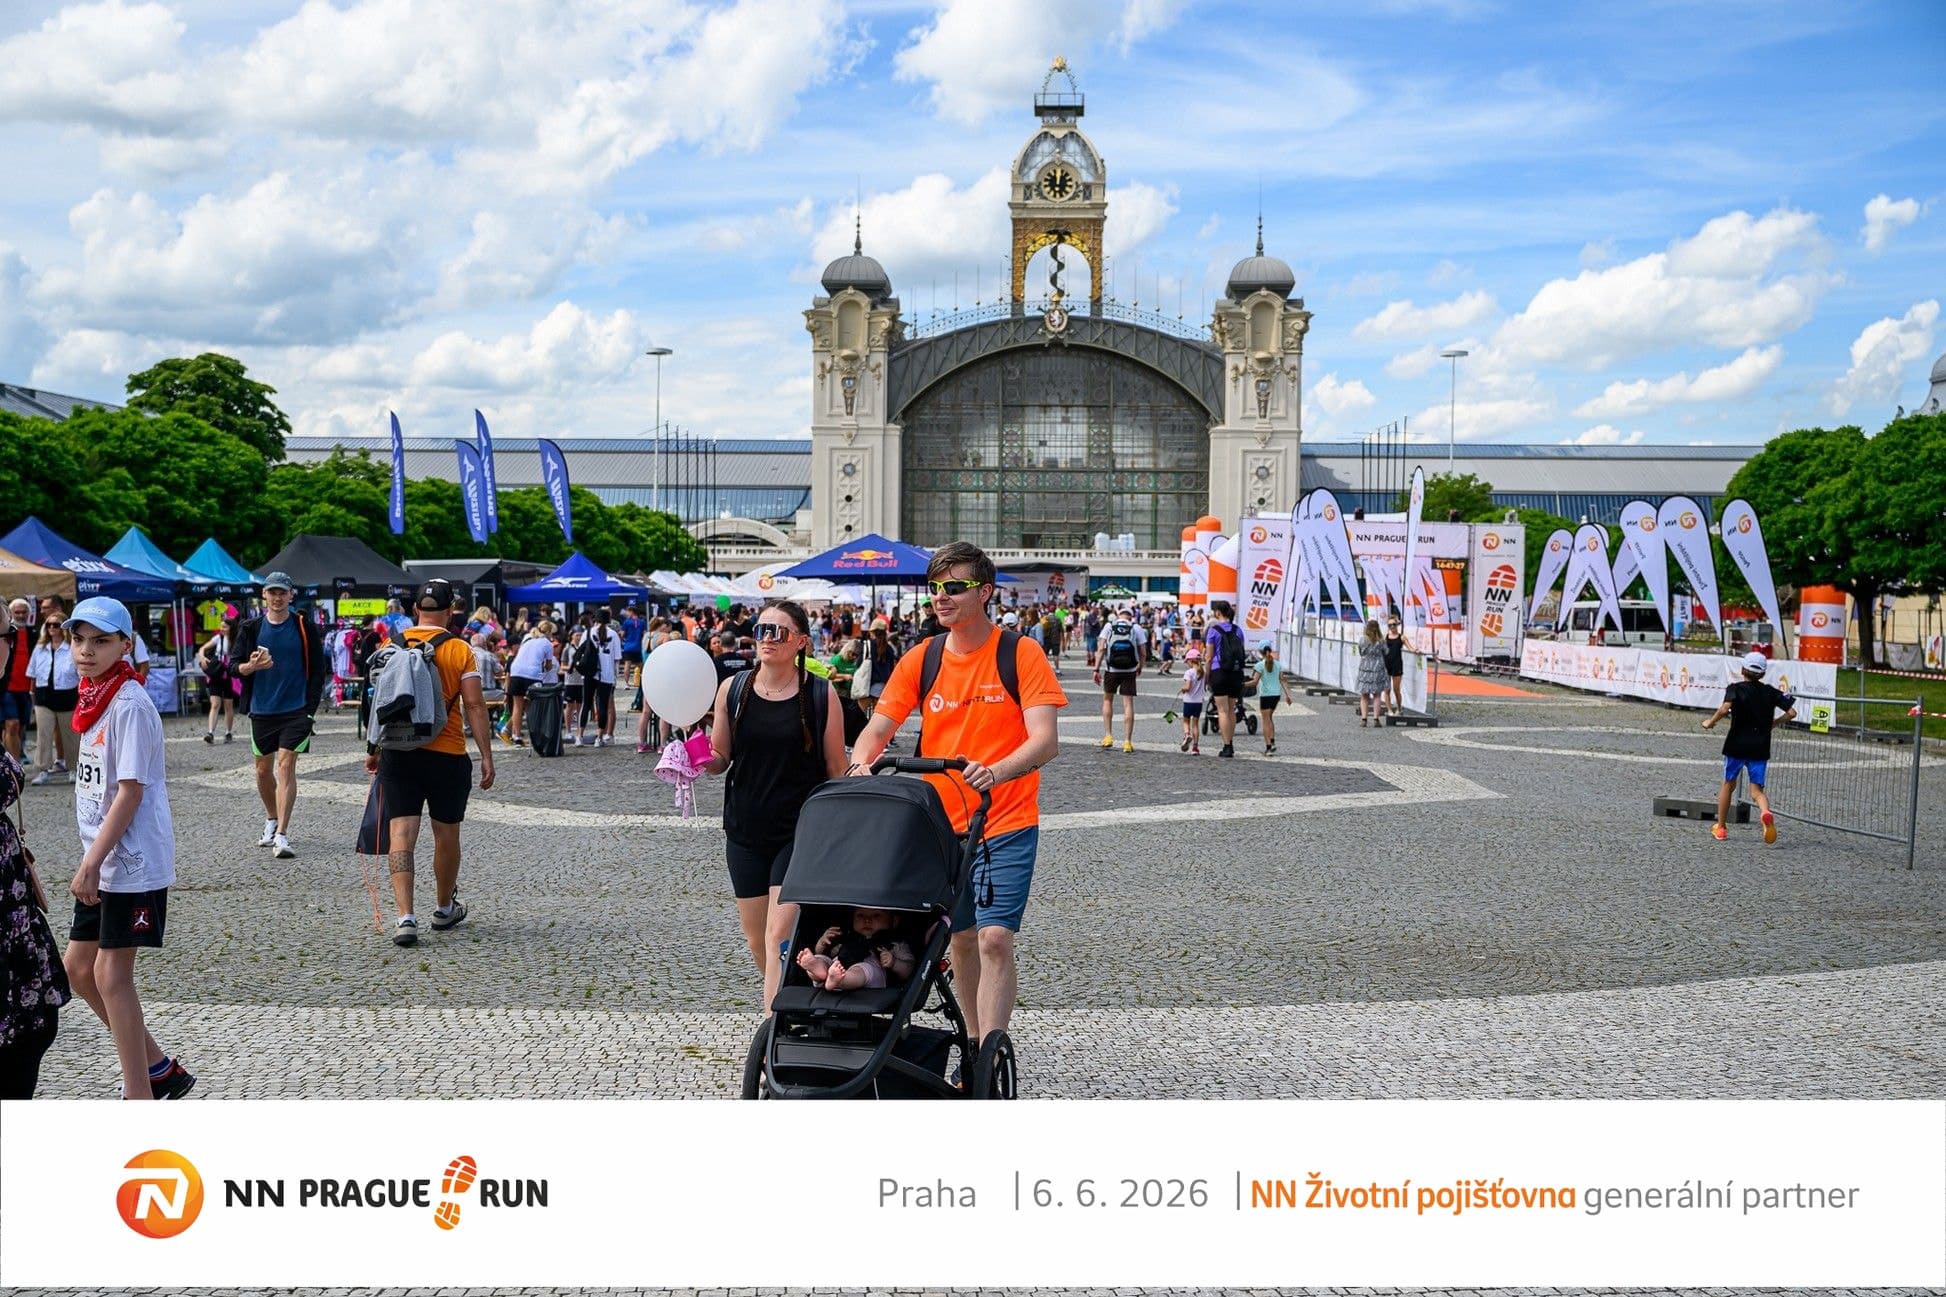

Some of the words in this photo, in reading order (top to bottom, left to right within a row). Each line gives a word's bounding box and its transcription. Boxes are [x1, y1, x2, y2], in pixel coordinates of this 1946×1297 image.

[1374, 534, 1407, 543] PRAGUE
[1417, 536, 1435, 544] RUN
[832, 559, 864, 569] Red
[867, 559, 899, 569] Bull
[1251, 580, 1278, 596] NN
[1484, 587, 1512, 603] NN
[1252, 599, 1270, 607] RUN
[1486, 605, 1504, 613] RUN
